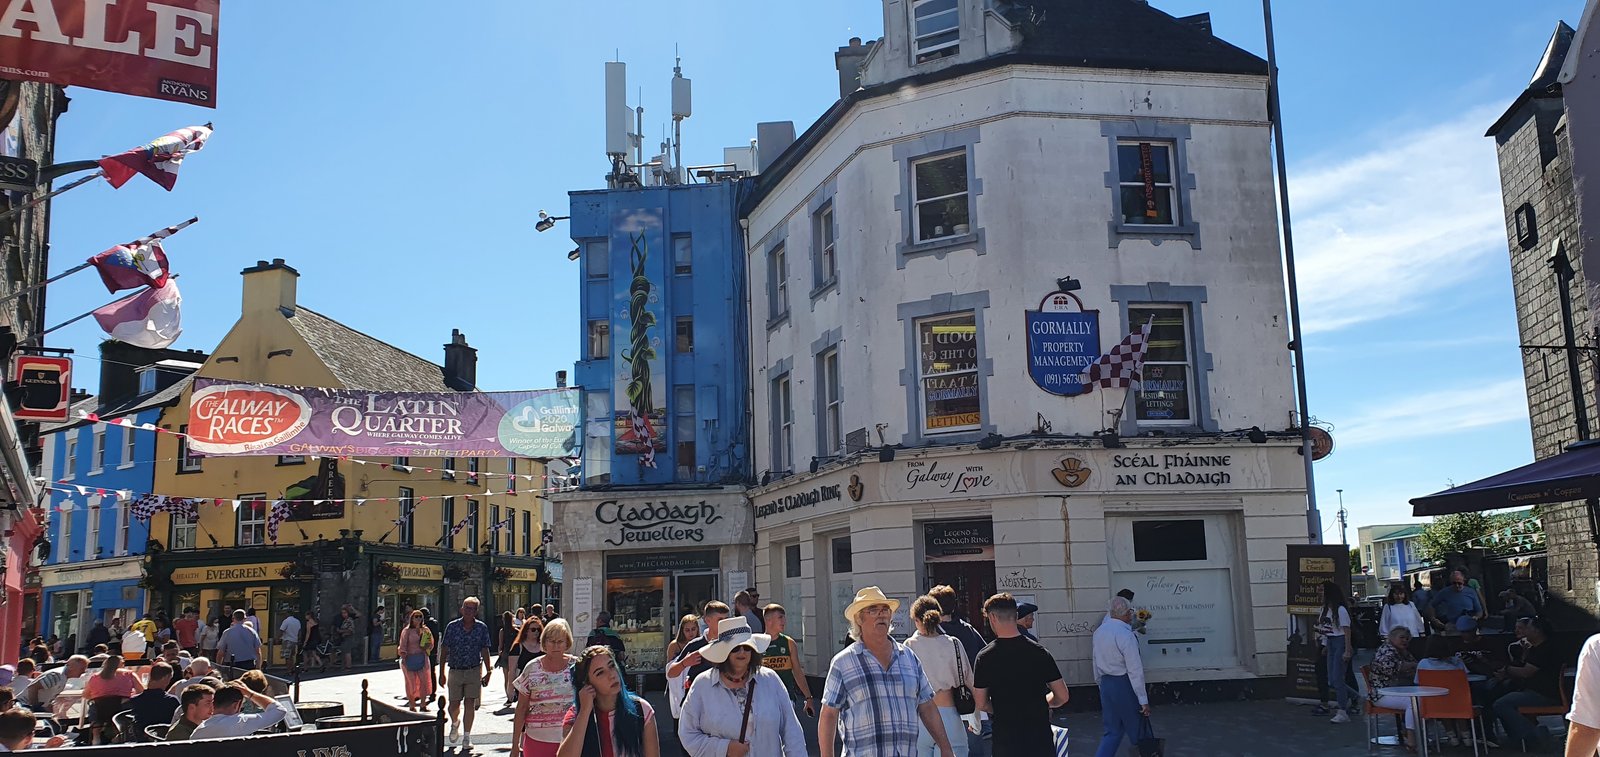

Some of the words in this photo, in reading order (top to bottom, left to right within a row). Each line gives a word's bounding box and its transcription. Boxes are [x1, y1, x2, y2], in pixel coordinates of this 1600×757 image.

[162, 79, 192, 88] ANTHONY
[160, 83, 208, 100] RYANS
[1032, 321, 1092, 335] GORMALLY
[1042, 342, 1084, 353] PROPERTY
[1034, 355, 1095, 367] MANAGEMENT
[1044, 373, 1061, 387] (091)
[196, 395, 289, 420] GALWAY
[204, 400, 219, 408] THE
[333, 395, 362, 406] THE
[364, 393, 460, 417] LATIN
[1146, 400, 1174, 408] LETTINGS
[331, 405, 466, 436] QUARTER
[541, 415, 568, 424] 2020
[930, 414, 980, 428] LETTINGS
[208, 415, 274, 440] RACES
[540, 424, 575, 433] Galwa
[391, 432, 419, 440] GALWAY
[906, 461, 954, 490] Galway
[206, 566, 268, 581] EVERGREEN
[399, 566, 431, 578] VERGREEN
[1300, 585, 1315, 593] Irish
